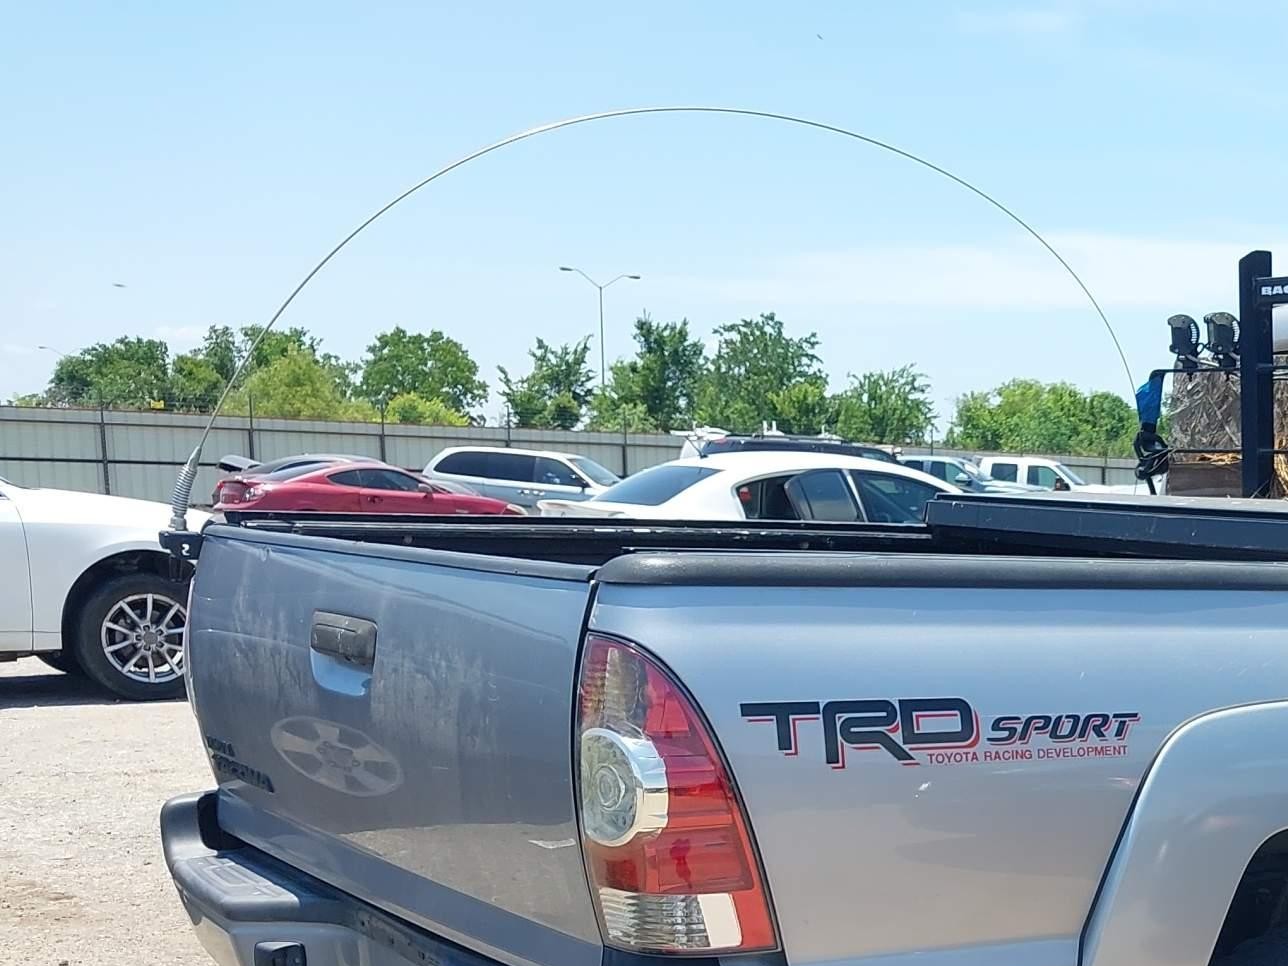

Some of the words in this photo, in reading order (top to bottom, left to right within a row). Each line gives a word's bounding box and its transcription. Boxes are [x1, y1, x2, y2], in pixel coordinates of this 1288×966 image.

[740, 697, 980, 769] TRD
[986, 711, 1139, 746] SPORT
[928, 752, 979, 765] TOYOTA
[984, 748, 1033, 761] RACING
[1037, 745, 1128, 759] DEVELOPMENT
